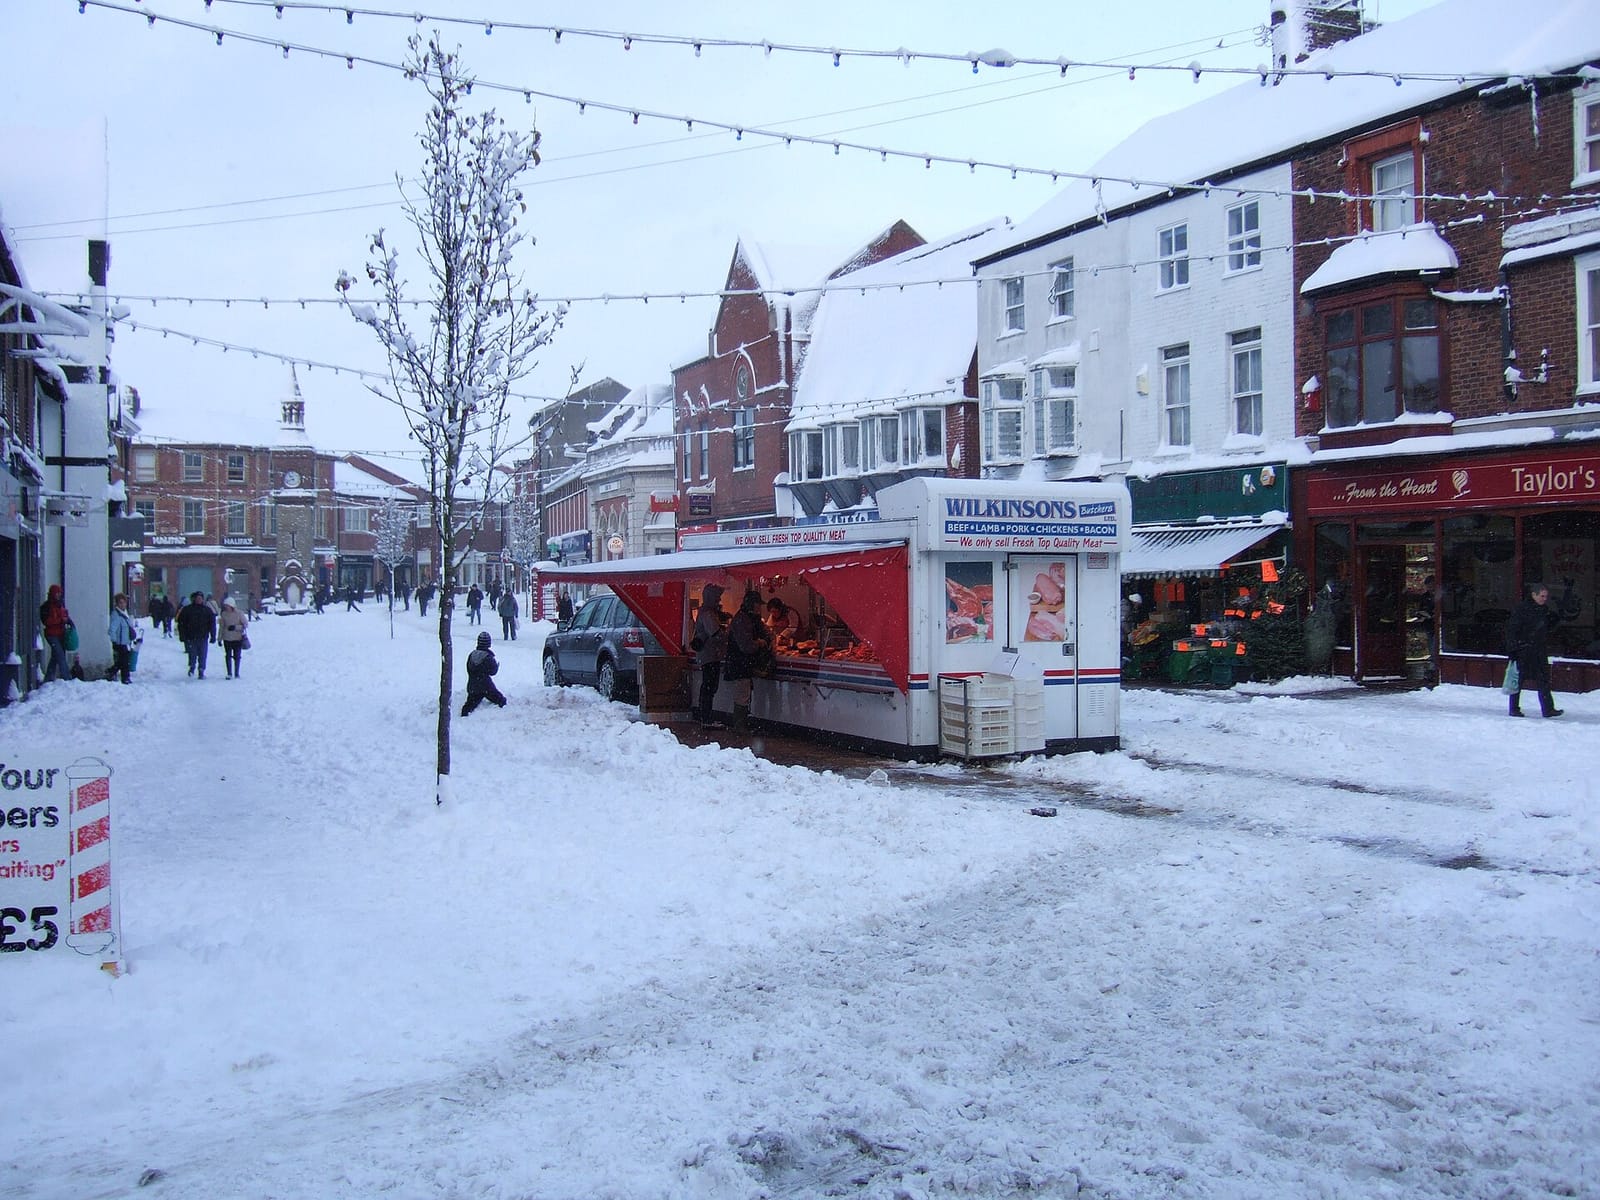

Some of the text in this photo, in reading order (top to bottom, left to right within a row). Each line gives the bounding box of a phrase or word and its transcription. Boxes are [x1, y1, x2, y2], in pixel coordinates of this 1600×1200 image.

[1379, 481, 1398, 498] the
[1399, 478, 1438, 496] Heart
[1511, 465, 1596, 496] Taylor's
[945, 498, 1077, 519] WILKINSONS
[735, 529, 846, 545] WE ONLY SELL FRESH TOP QUALITY MEAT
[947, 523, 1115, 534] BEEF LAMB PORK CHICKENS BACON
[112, 540, 141, 548] Clarks
[223, 537, 254, 545] HALIFAX
[960, 536, 1103, 549] We only sell Fresh Top Quality Meat
[0, 763, 60, 790] our
[0, 906, 59, 952] £5
